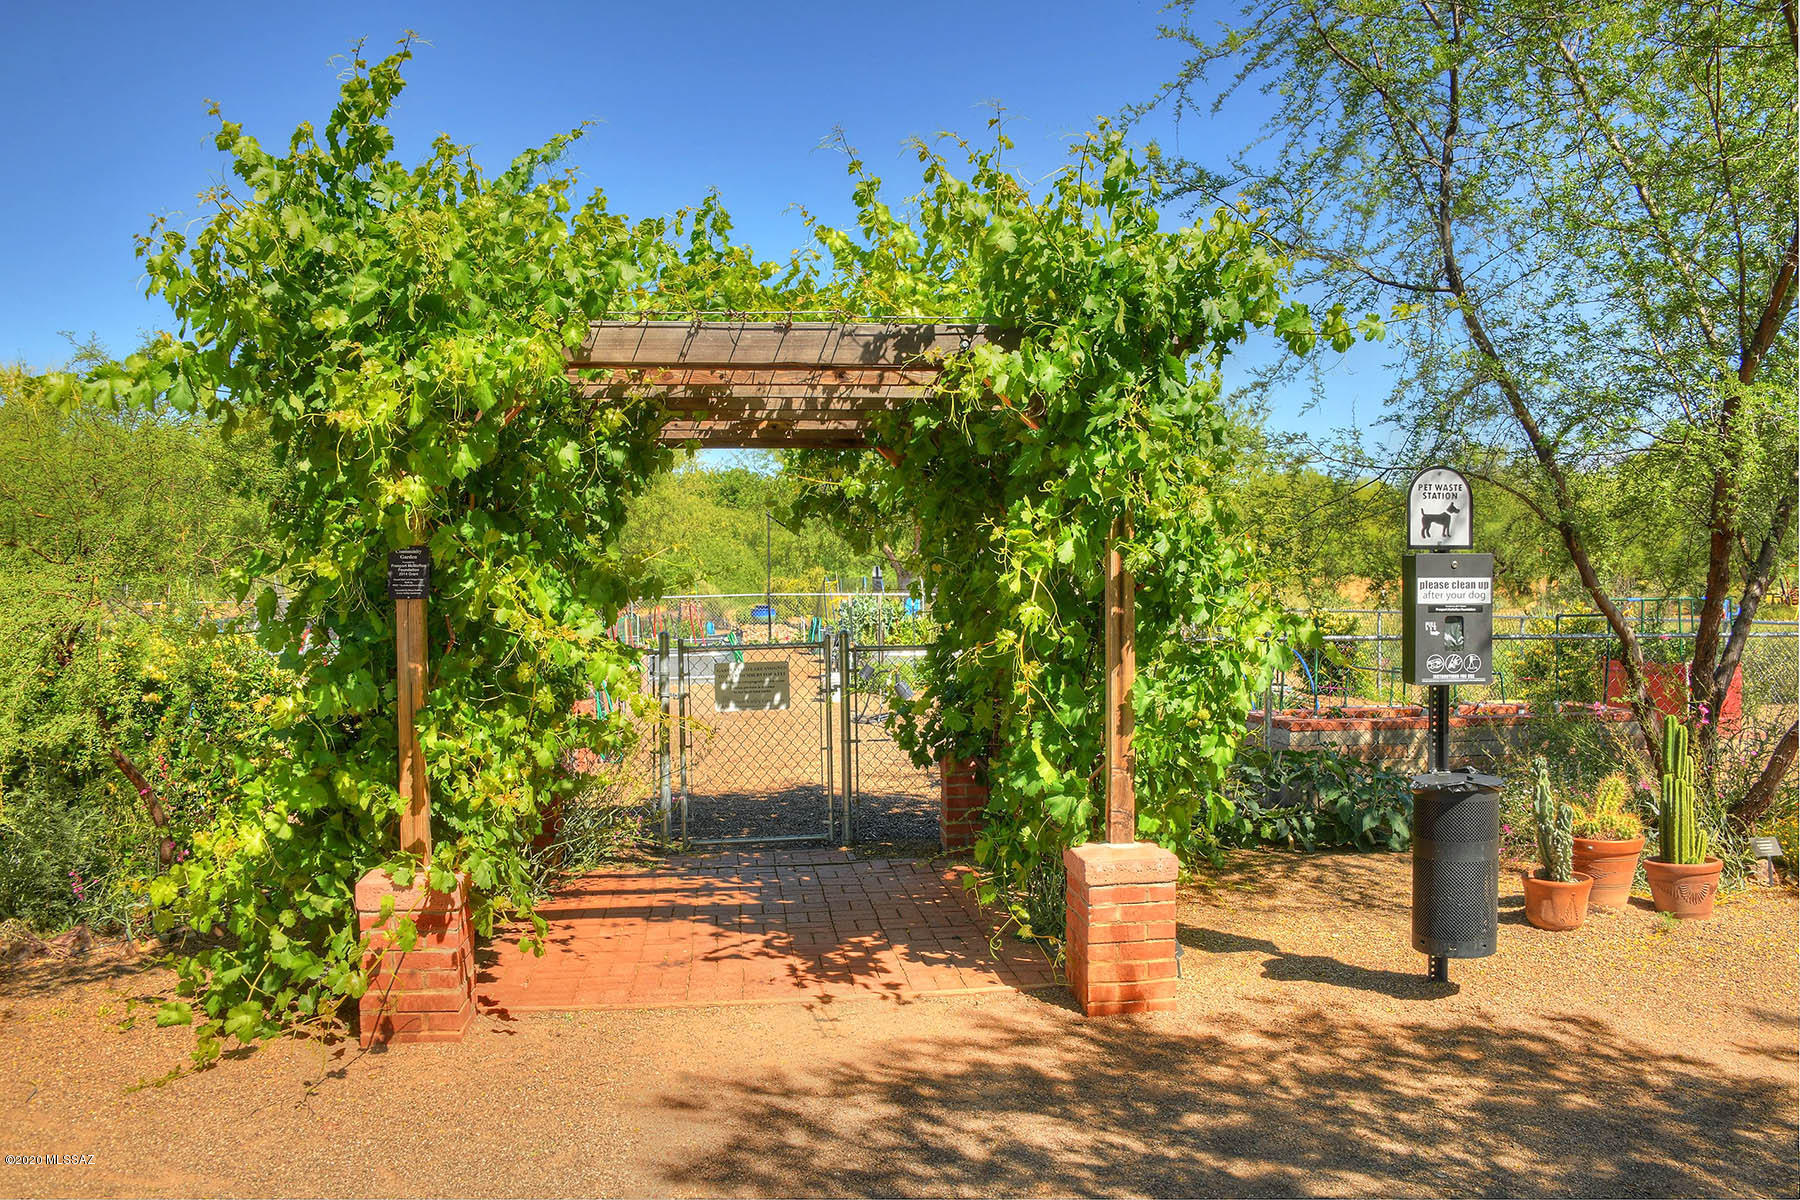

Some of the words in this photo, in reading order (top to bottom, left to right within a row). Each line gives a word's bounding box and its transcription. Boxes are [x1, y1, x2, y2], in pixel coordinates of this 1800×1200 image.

[1422, 492, 1458, 500] STATION
[1419, 581, 1450, 590] please
[1451, 581, 1476, 589] clean
[1478, 581, 1489, 590] up
[1422, 590, 1444, 599] after
[1445, 591, 1466, 600] your
[1468, 590, 1486, 601] dog
